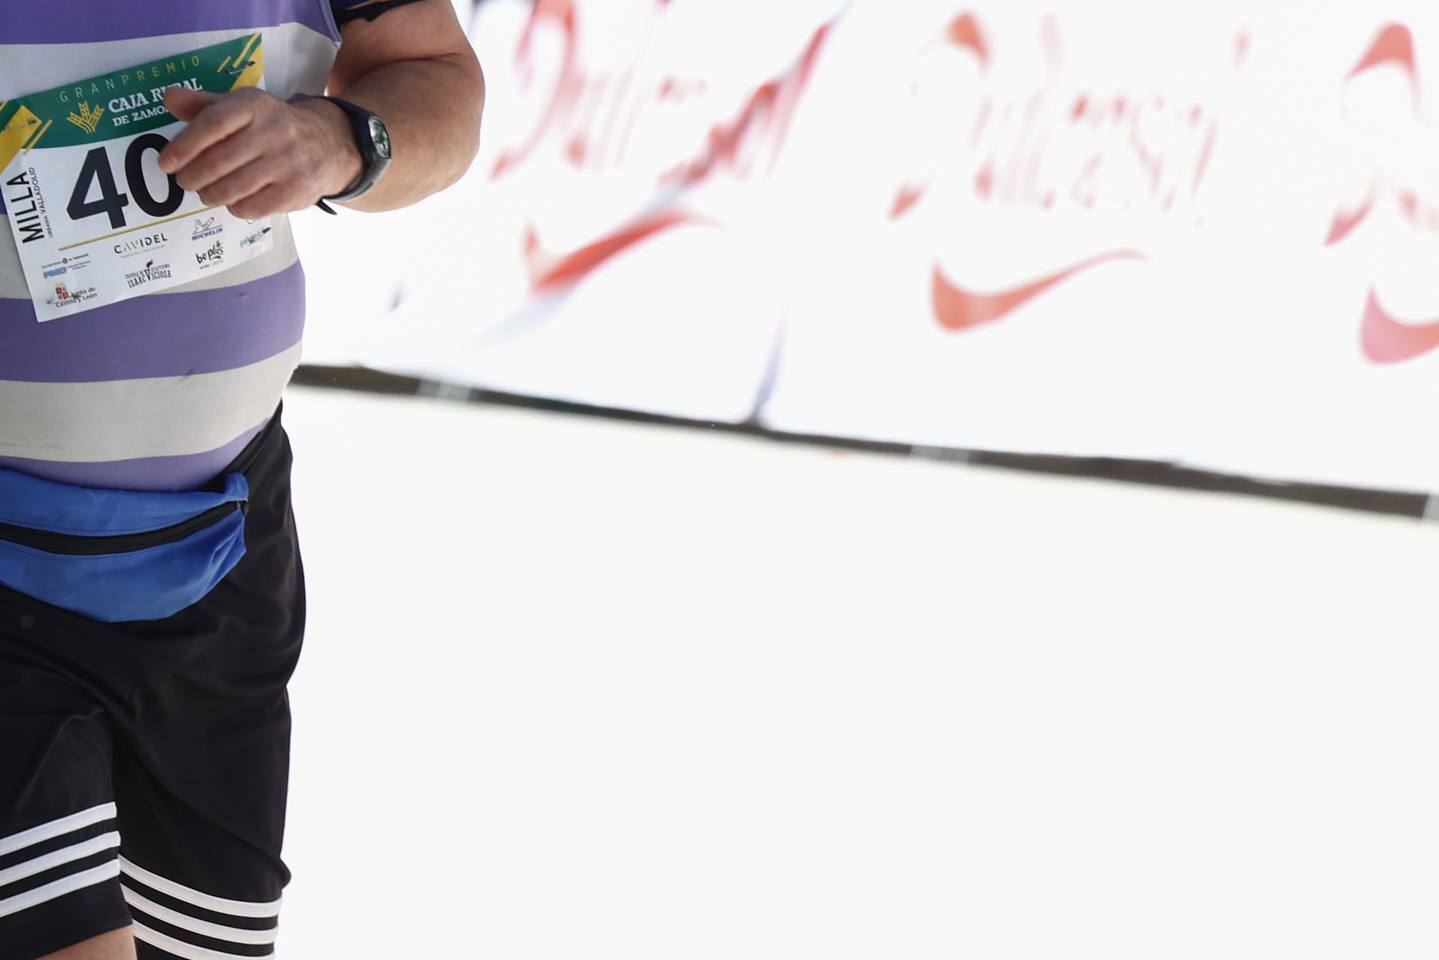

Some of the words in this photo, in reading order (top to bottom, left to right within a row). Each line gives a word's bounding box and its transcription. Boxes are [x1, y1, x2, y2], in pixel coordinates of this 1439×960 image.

[108, 92, 150, 113] CAJA
[150, 77, 203, 102] RAL
[112, 115, 130, 127] DE
[131, 105, 169, 121] ZAMO
[6, 171, 45, 244] MILLA
[28, 167, 46, 214] VALLADOLID
